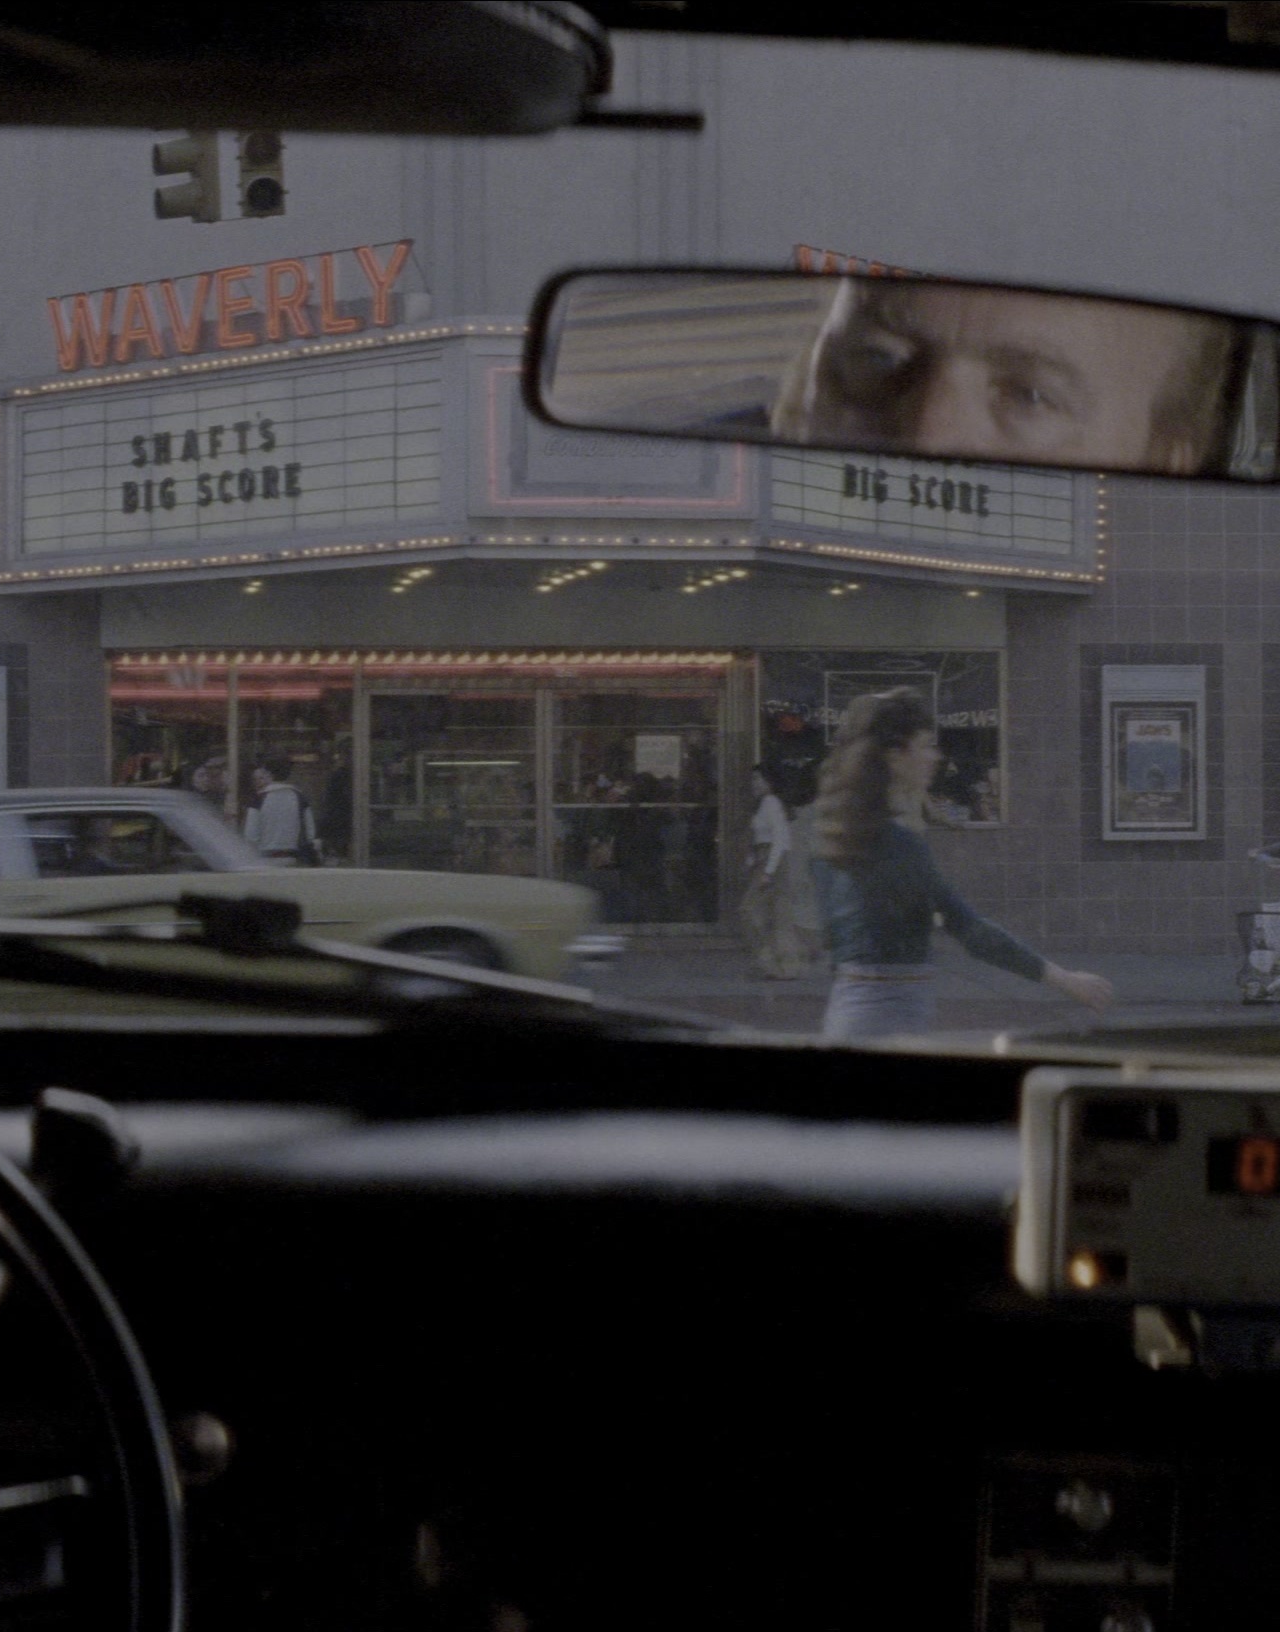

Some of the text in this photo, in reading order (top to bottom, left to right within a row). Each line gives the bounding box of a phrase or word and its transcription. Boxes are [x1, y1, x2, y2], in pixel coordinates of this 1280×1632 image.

[47, 239, 413, 371] WAVERLY
[122, 462, 302, 513] BIG SCORE
[843, 463, 990, 517] BIG SCORE
